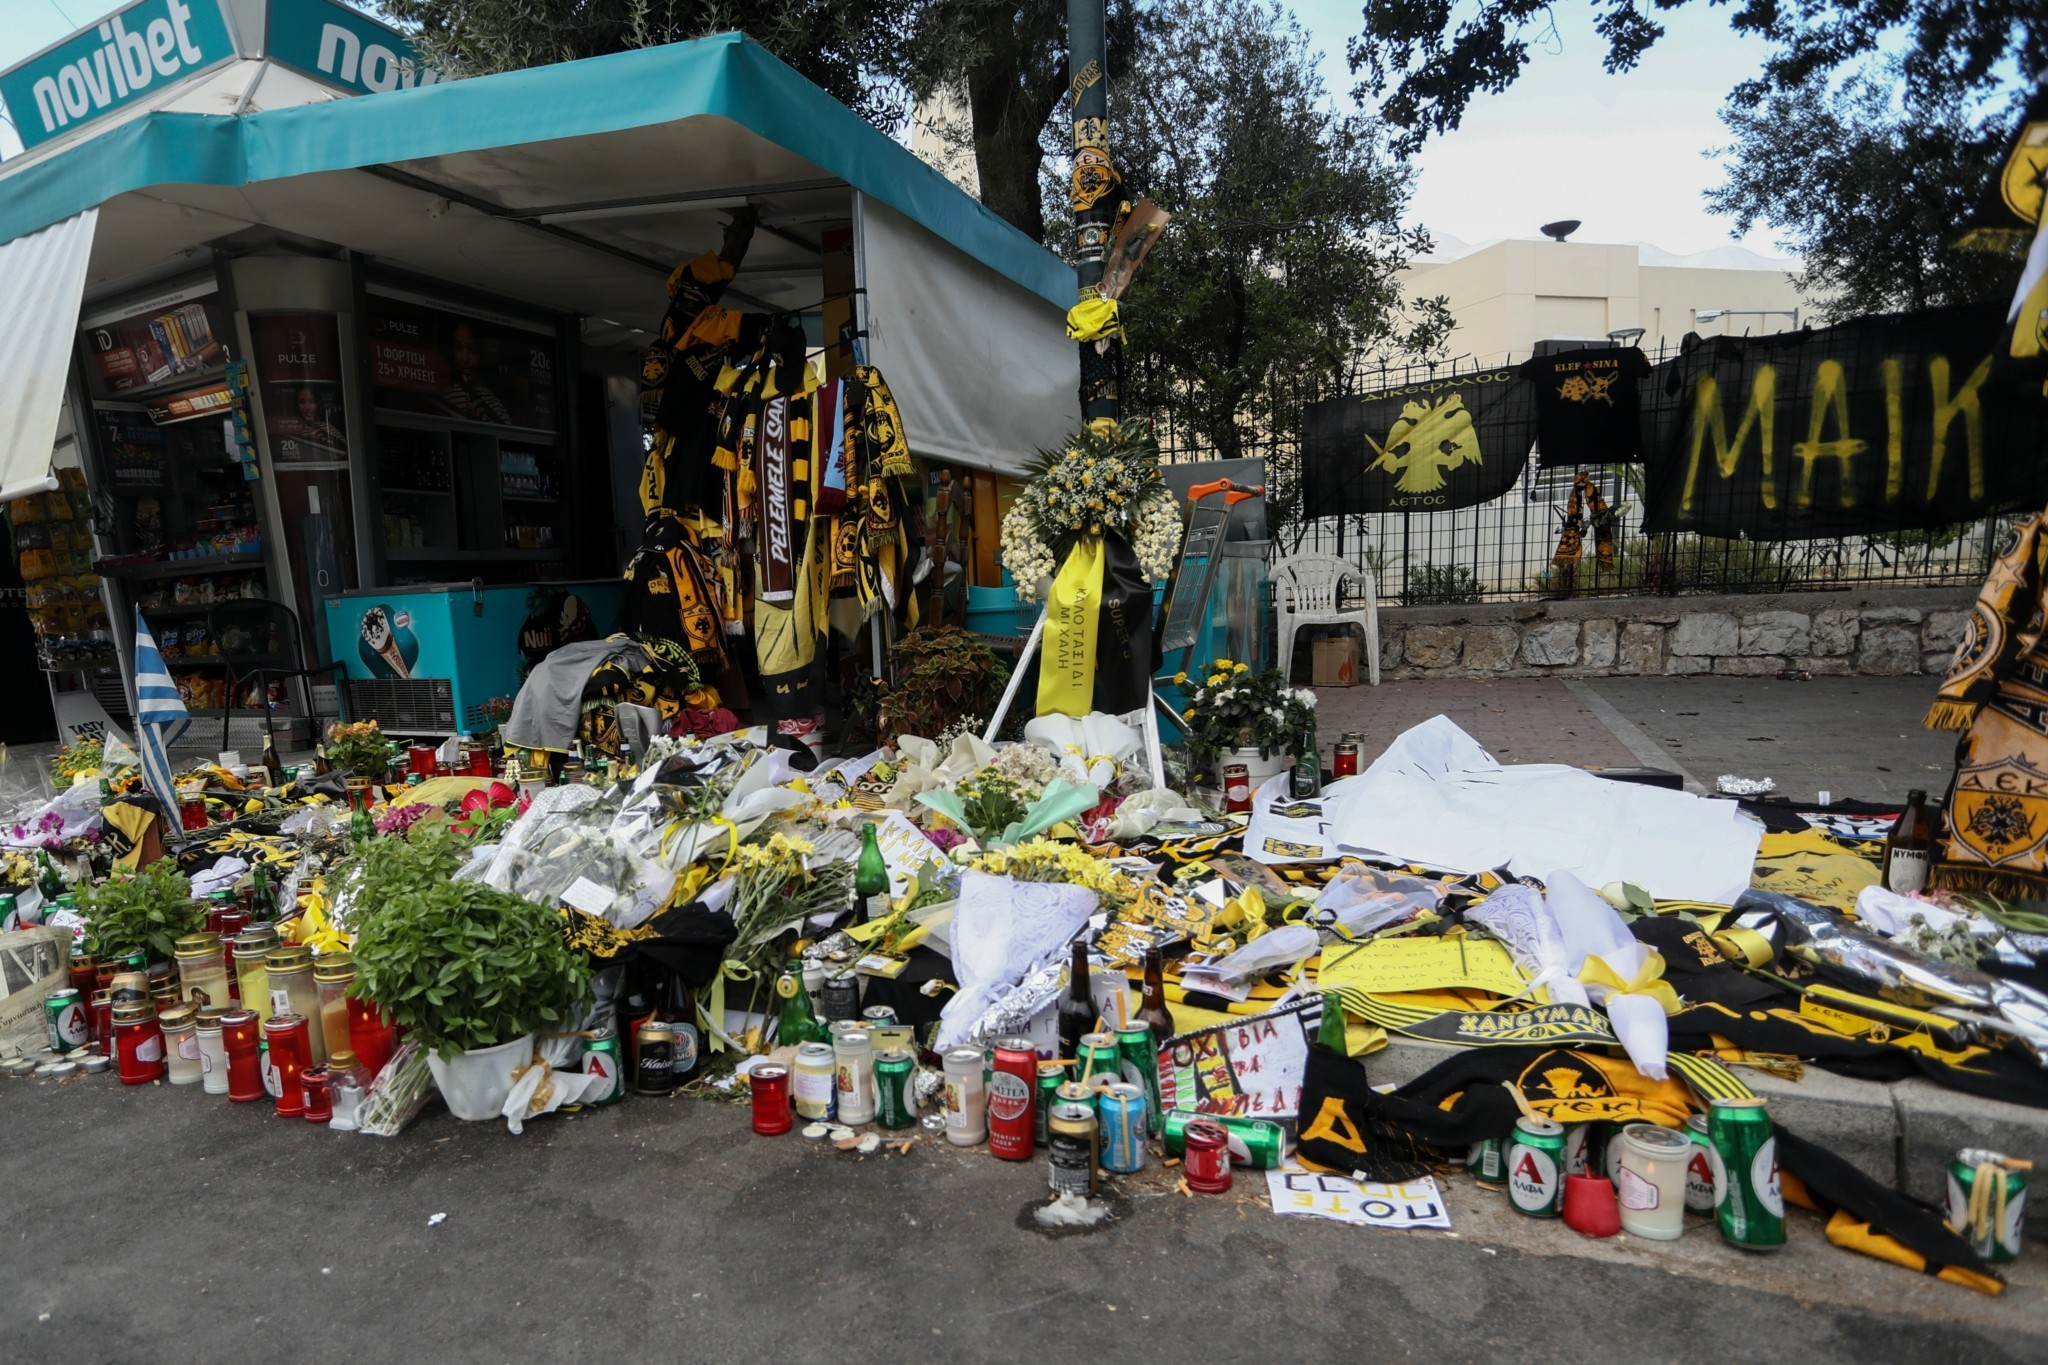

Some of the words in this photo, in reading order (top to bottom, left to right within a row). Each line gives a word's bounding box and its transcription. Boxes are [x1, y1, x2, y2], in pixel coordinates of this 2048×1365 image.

[32, 0, 202, 133] novibet
[389, 320, 419, 335] PULZE
[96, 329, 113, 351] iD
[278, 354, 317, 364] PULZE
[383, 347, 426, 365] ΦΟΡΤΙΣΗ
[397, 366, 437, 383] ΧΡΗΣΕΙΣ
[1554, 361, 1581, 372] ELEF
[1592, 359, 1619, 370] SINA
[766, 442, 789, 564] PELEMELE
[1107, 599, 1130, 646] SUPER
[69, 721, 104, 737] TASTY
[1238, 1019, 1279, 1049] ΒΙΑ
[1513, 1151, 1544, 1184] Α
[1512, 1181, 1545, 1195] ΑΛΦΑ
